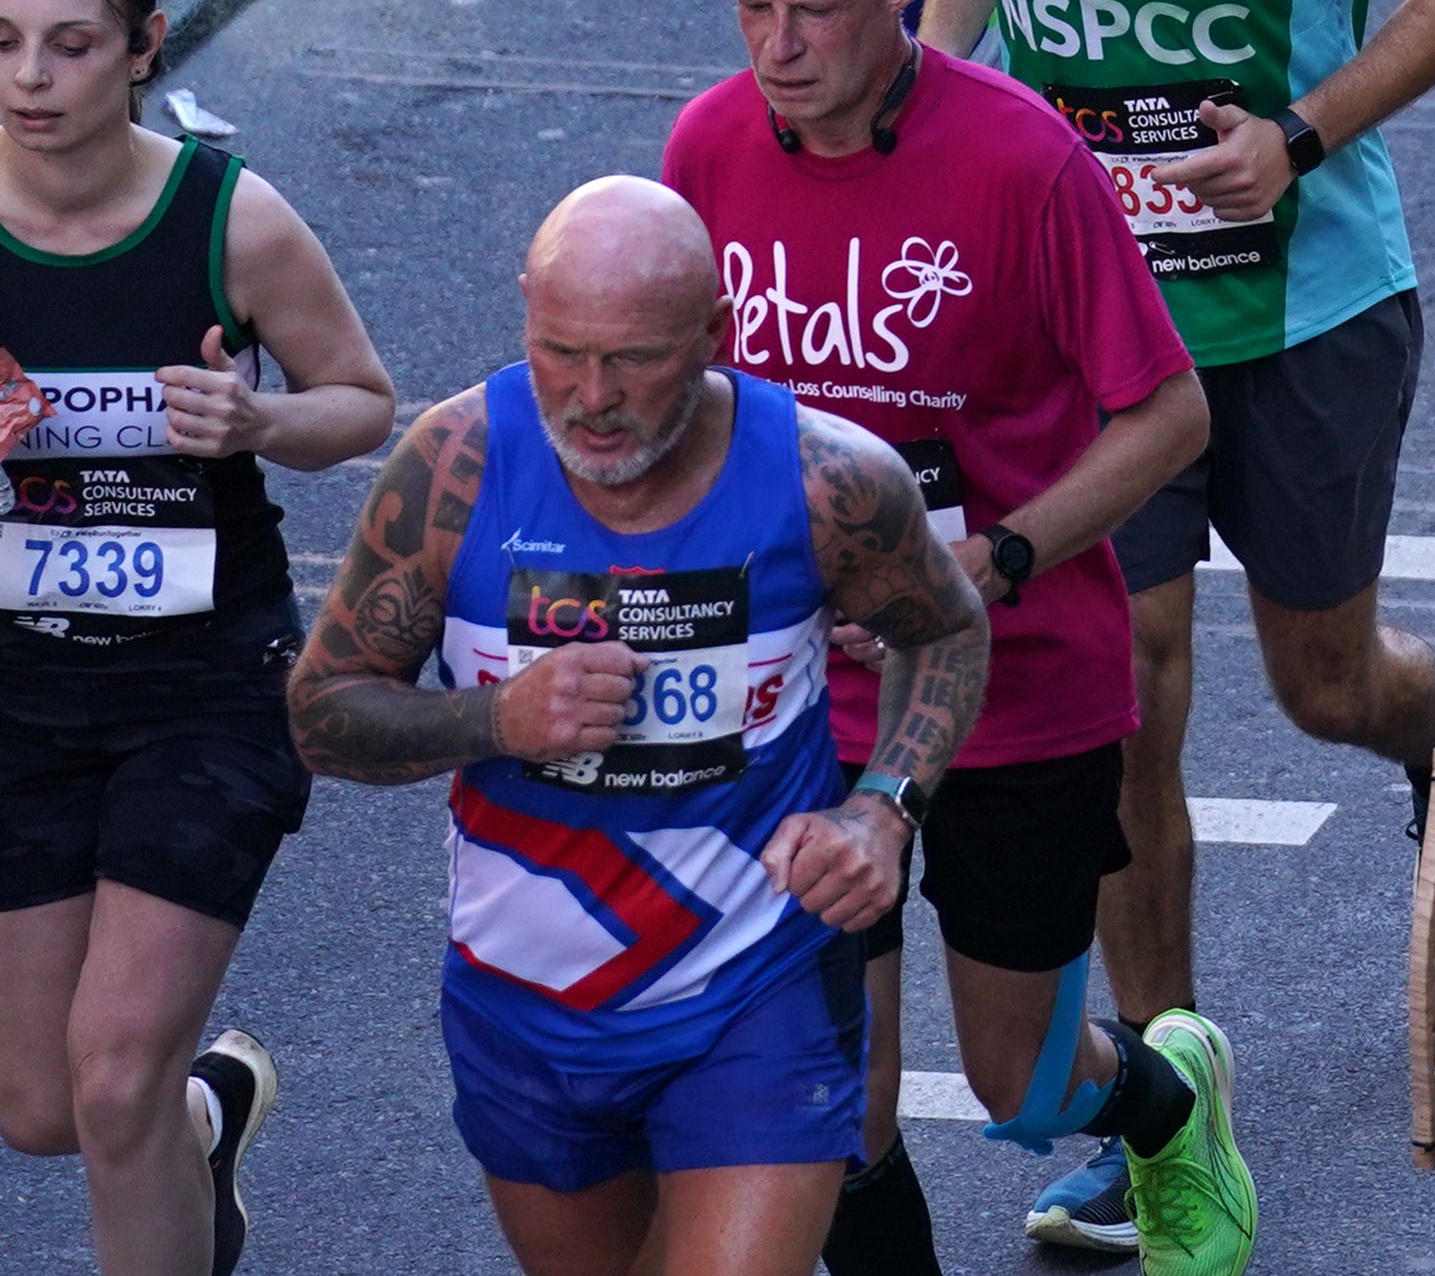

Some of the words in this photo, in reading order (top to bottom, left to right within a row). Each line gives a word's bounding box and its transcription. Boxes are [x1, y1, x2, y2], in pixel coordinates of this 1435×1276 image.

[1124, 96, 1171, 113] TATA
[1128, 108, 1201, 129] CONSULTA
[1131, 126, 1199, 144] SERVICES
[1152, 258, 1186, 274] new
[1188, 250, 1261, 271] balance
[723, 236, 910, 373] Petals
[788, 378, 820, 397] Loss
[822, 381, 907, 408] Counselling
[909, 390, 968, 411] Charity
[80, 470, 131, 484] TATA
[82, 485, 198, 503] CONSULTANCY
[84, 501, 156, 517] SERVICES
[512, 538, 567, 554] Scimitar
[25, 538, 165, 598] 7339
[618, 589, 671, 604] TATA
[528, 585, 609, 639] tcs
[618, 600, 735, 624] CONSULTANCY
[618, 622, 696, 642] SERVICES
[604, 770, 645, 789] new
[650, 764, 727, 788] balance
